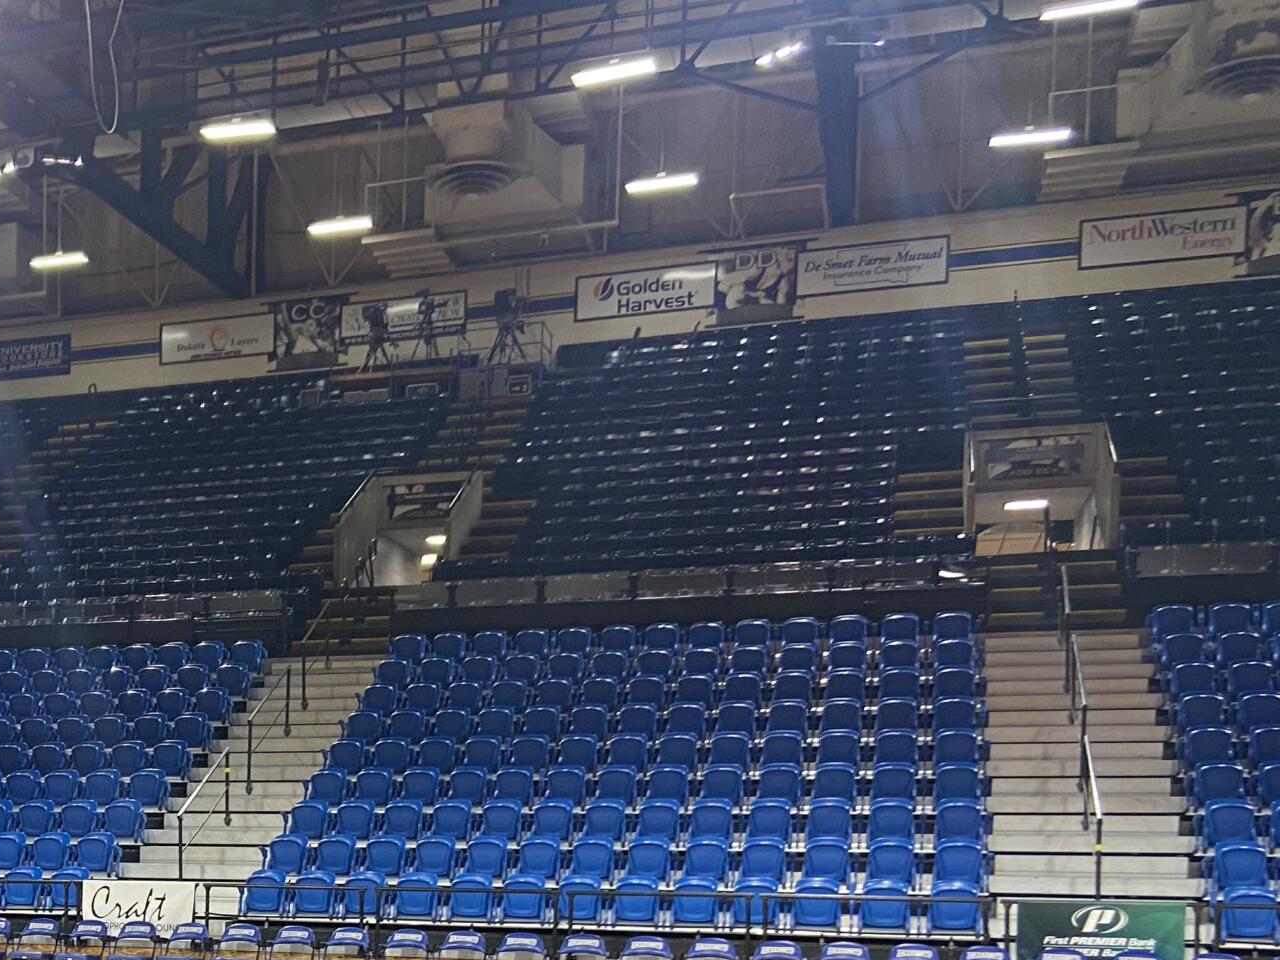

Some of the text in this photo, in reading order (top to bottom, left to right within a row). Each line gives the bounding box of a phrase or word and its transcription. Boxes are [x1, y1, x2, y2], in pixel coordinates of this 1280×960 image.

[1090, 216, 1237, 244] NorthWestern
[857, 255, 891, 267] Farm
[895, 247, 944, 263] Mutual
[617, 277, 683, 296] Golden
[617, 292, 695, 314] Harvest
[91, 885, 167, 923] Craft
[1043, 936, 1157, 948] First PREMIER Bank
